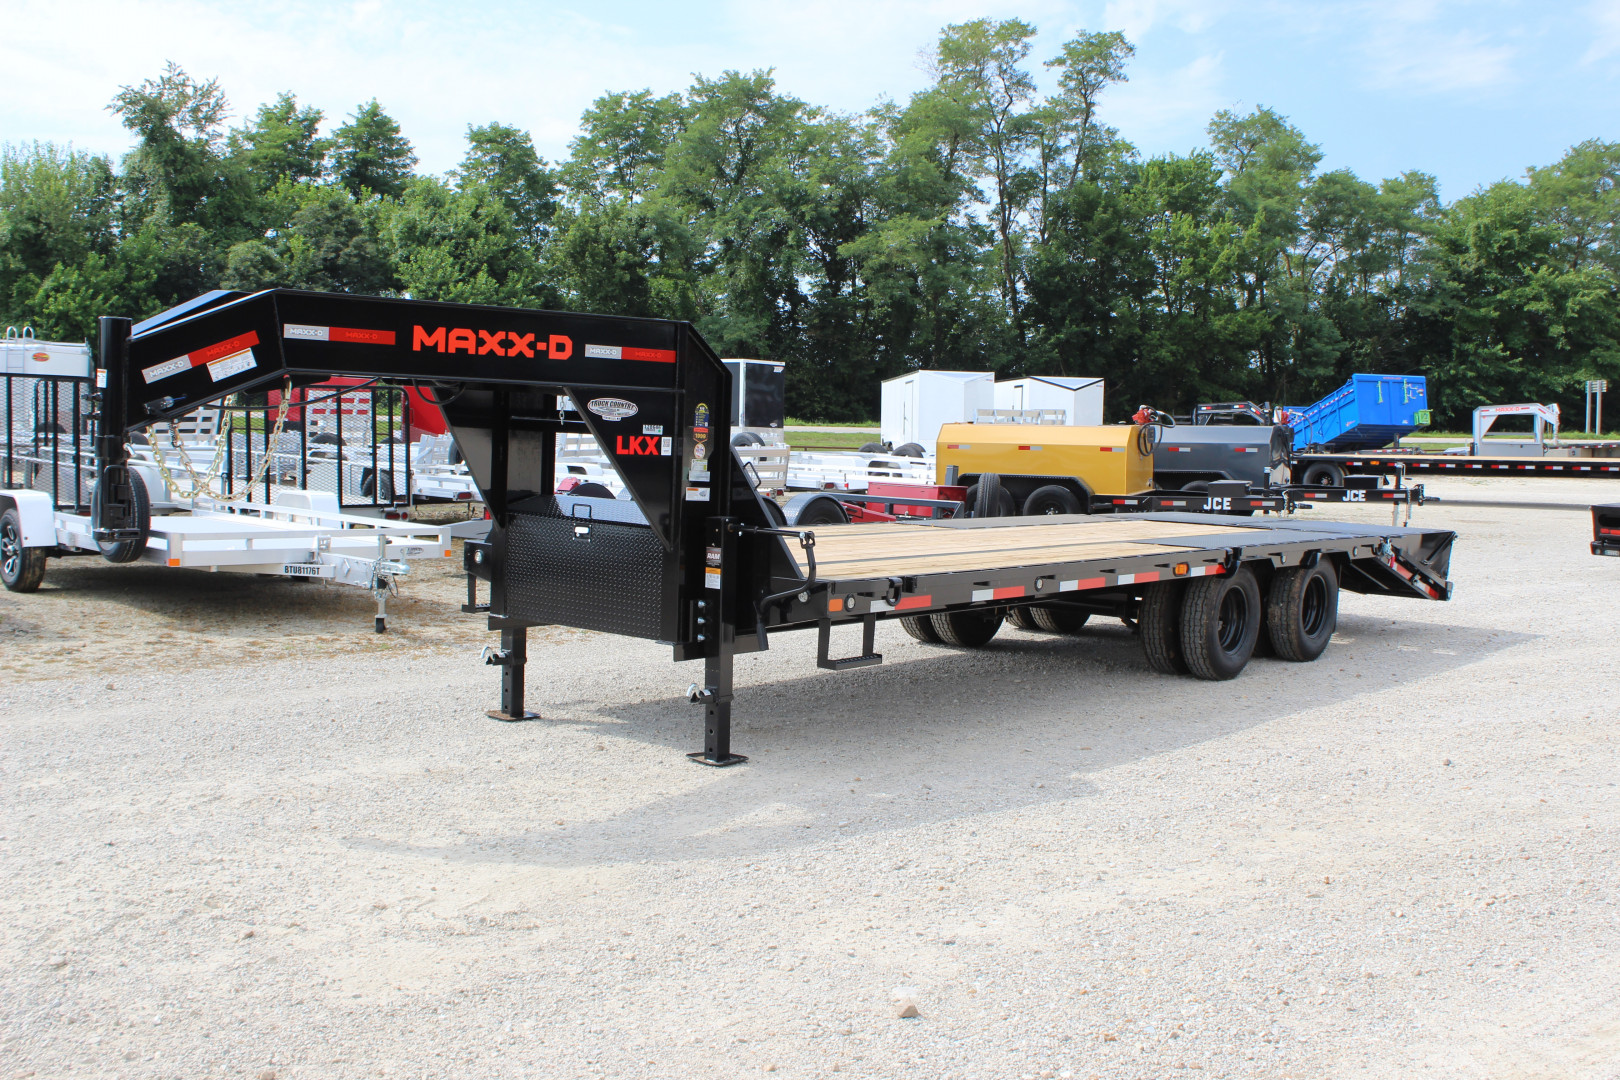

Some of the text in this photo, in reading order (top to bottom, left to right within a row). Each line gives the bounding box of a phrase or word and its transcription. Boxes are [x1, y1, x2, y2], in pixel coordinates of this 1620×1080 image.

[289, 327, 324, 337] MAXX-D
[412, 324, 573, 361] MAXX-D
[589, 346, 617, 356] MAXX-D
[149, 360, 185, 378] MAXX-D
[591, 400, 635, 411] TRUCK COUNTRY
[616, 435, 660, 456] LKX
[1342, 490, 1367, 501] JCE
[1203, 497, 1232, 510] JCE
[284, 565, 320, 576] BTU81176T
